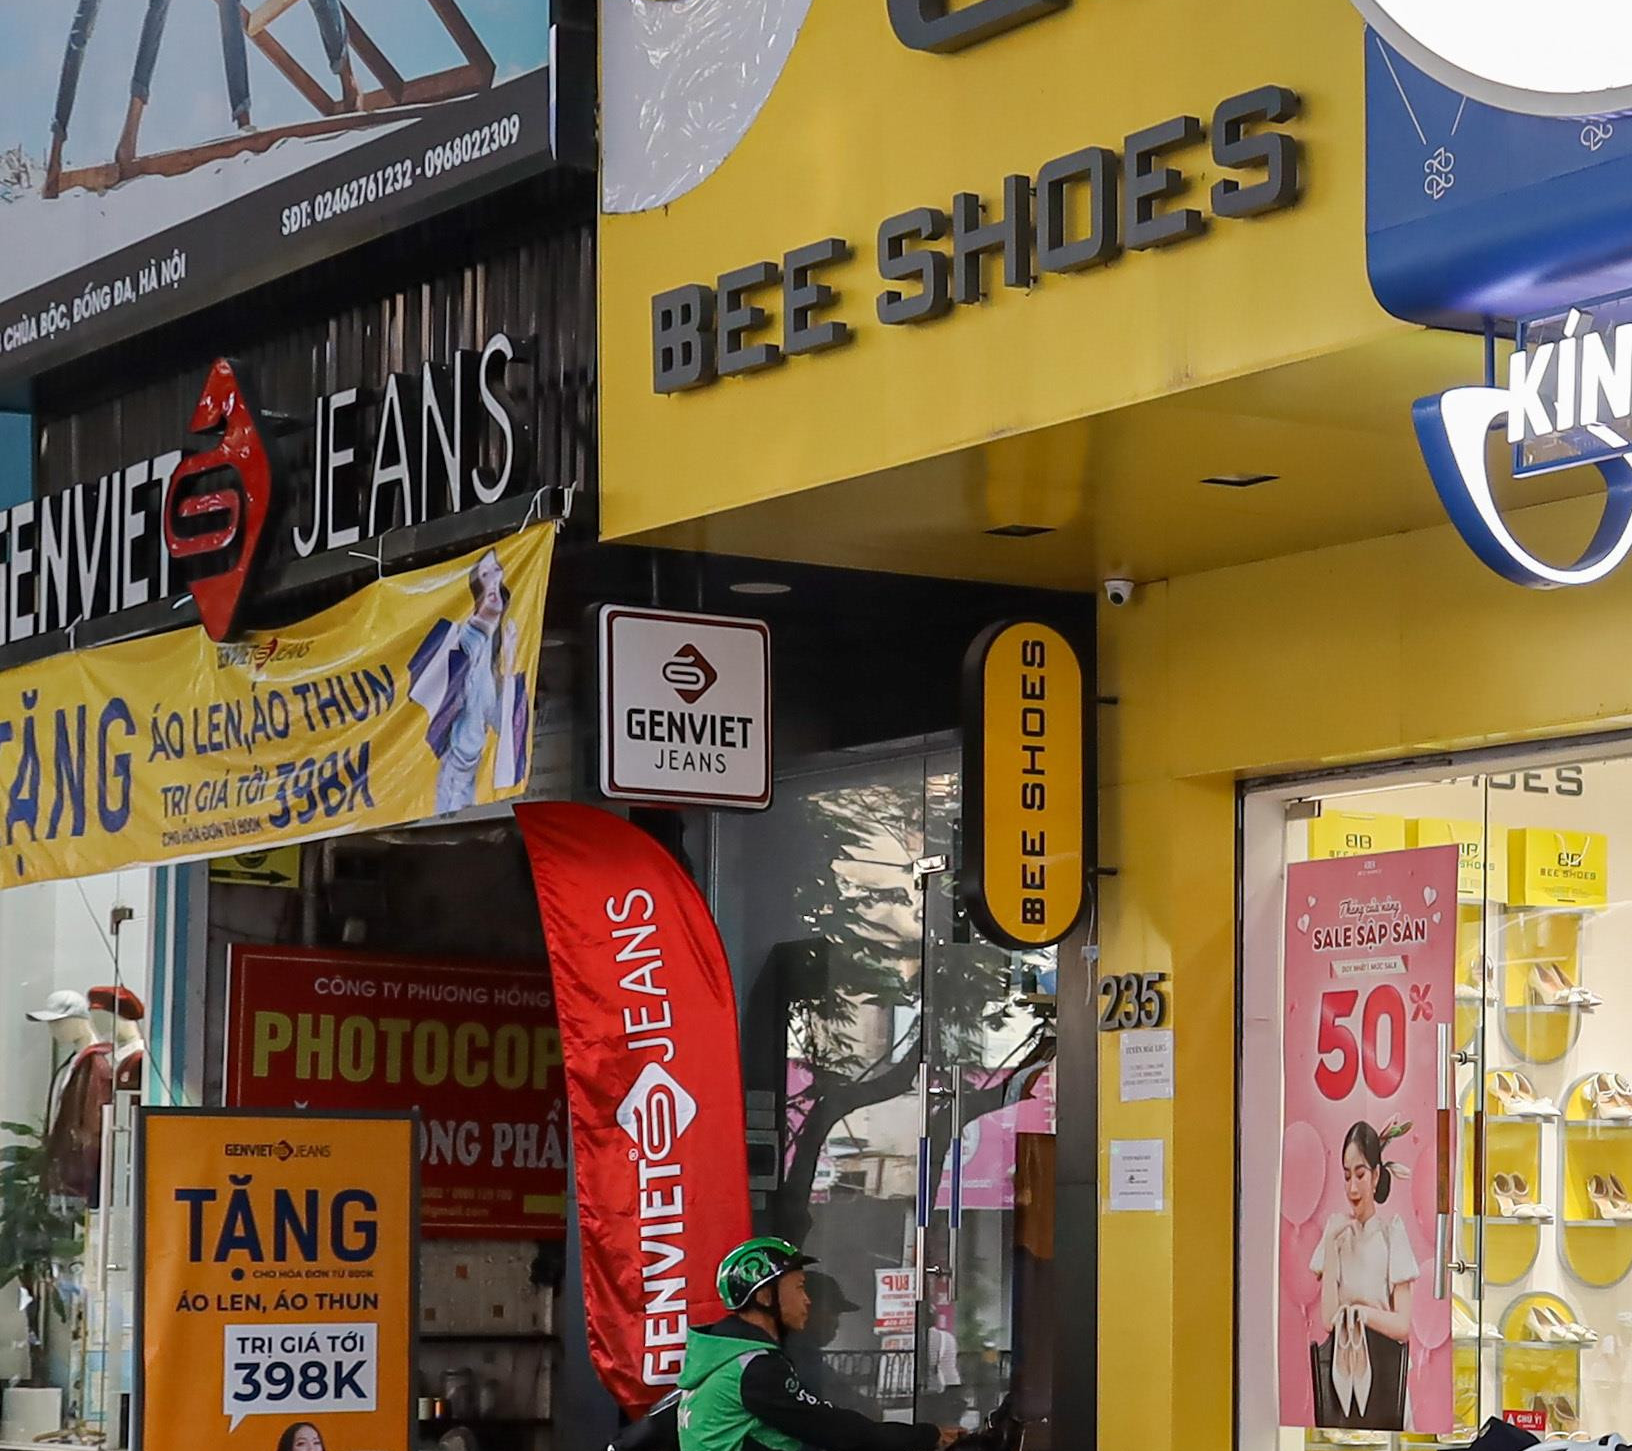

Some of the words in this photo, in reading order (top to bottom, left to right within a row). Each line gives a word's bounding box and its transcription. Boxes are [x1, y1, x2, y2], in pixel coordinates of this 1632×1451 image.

[281, 200, 311, 236] SĐT:
[314, 159, 413, 222] 02462761232
[424, 114, 520, 178] 0968022309
[652, 238, 855, 396] BEE
[877, 84, 1301, 326] SHOES
[4, 314, 38, 351] CHÙA
[73, 282, 111, 323] ĐỐNG
[114, 276, 136, 306] ĐA,
[139, 259, 158, 295] HÀ
[161, 248, 186, 288] NỘI
[292, 333, 515, 558] JEANS
[148, 703, 184, 762] ÁO
[292, 664, 396, 732] THUN
[625, 707, 753, 750] GENVIET
[1021, 639, 1046, 812] SHOES
[195, 769, 231, 813] GIÁ
[654, 749, 728, 775] JEANS
[1021, 830, 1046, 925] BEE
[1313, 928, 1352, 950] SALE
[1356, 919, 1388, 950] SẬP
[1392, 914, 1426, 943] SÀN
[314, 977, 376, 997] CÔNG
[383, 983, 402, 998] TY
[408, 983, 488, 1003] PHƯƠNG
[606, 888, 673, 1064] JEANS
[1098, 972, 1163, 1031] 235
[252, 1011, 565, 1089] PHOTOCOP
[1314, 982, 1433, 1101] 50%
[225, 1144, 273, 1157] GENVIET
[294, 1145, 331, 1157] JEANS
[174, 1174, 379, 1282] TẶNG
[176, 1288, 209, 1312] ÁO
[217, 1294, 267, 1314] LEN,
[273, 1288, 309, 1312] ÁO
[315, 1292, 379, 1312] THUN
[639, 1159, 688, 1386] GENVIET
[232, 1359, 367, 1403] 398K
[236, 1336, 273, 1360] TRỊ
[280, 1332, 321, 1354] GIÁ
[327, 1331, 365, 1354] TỚI
